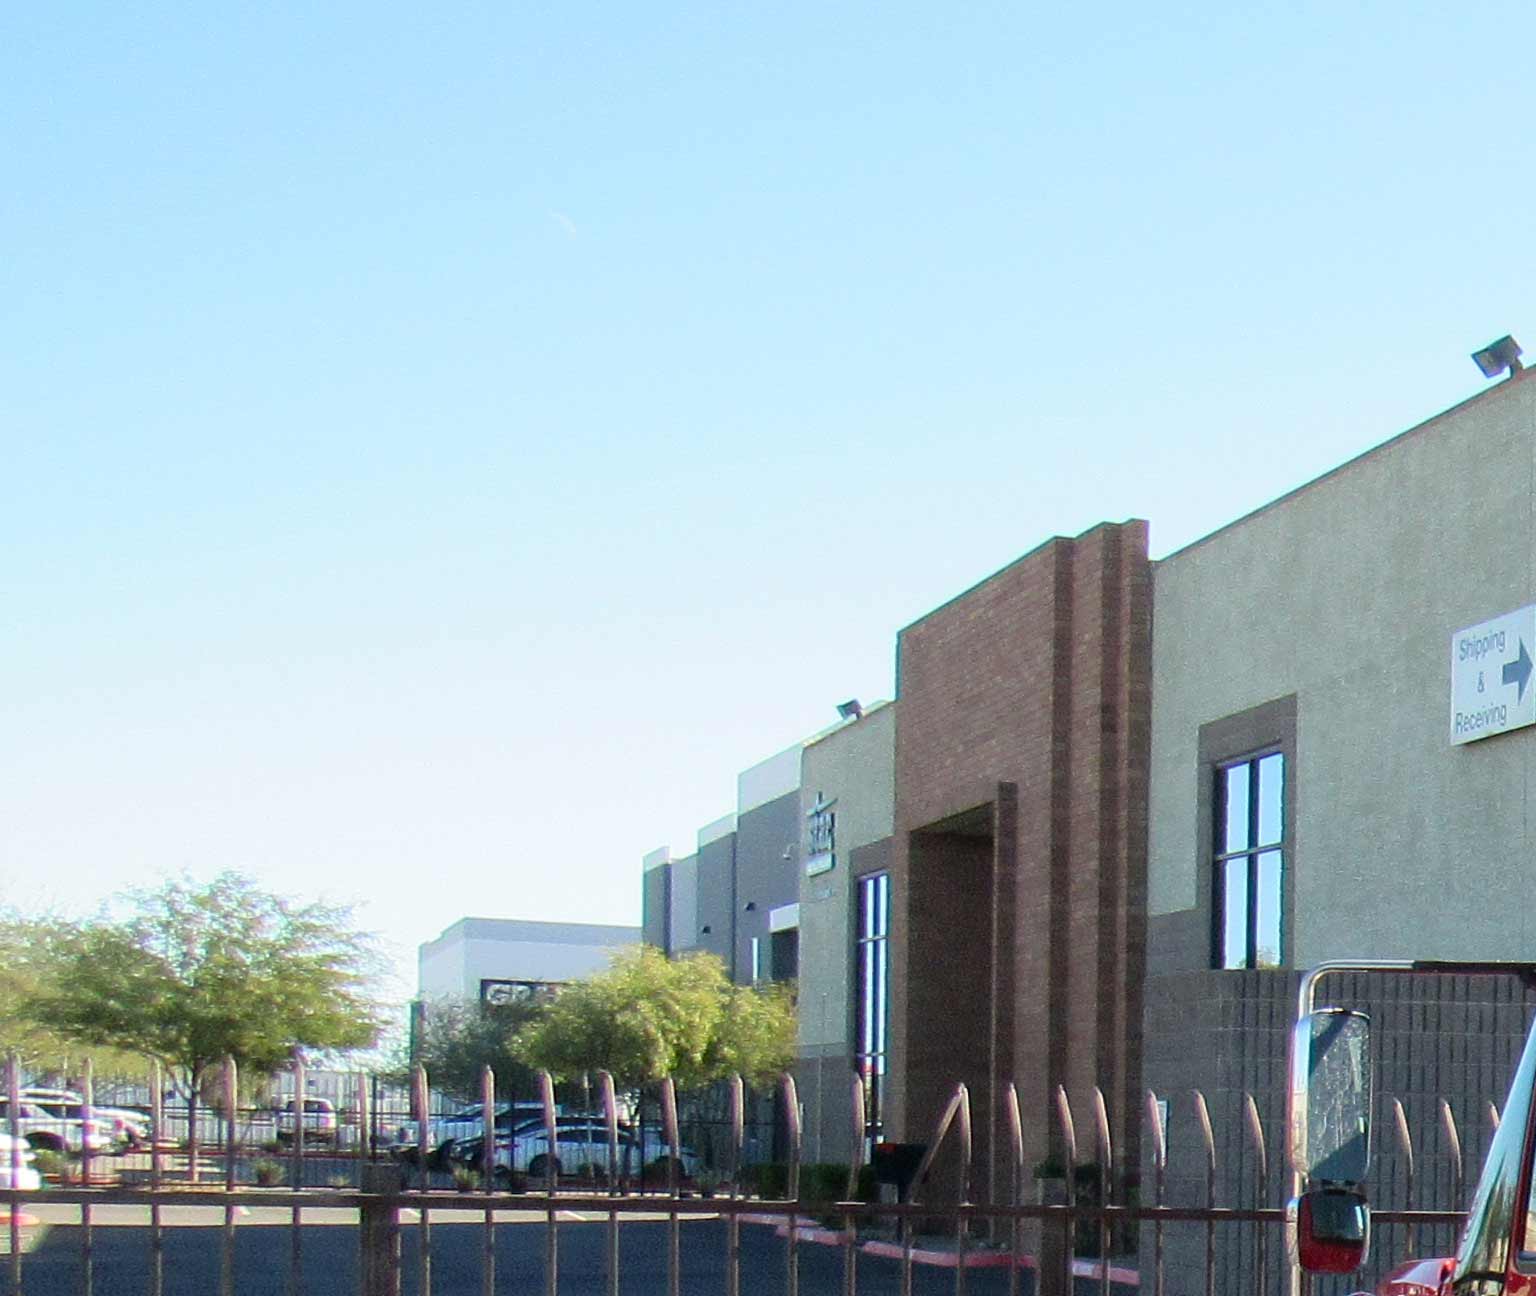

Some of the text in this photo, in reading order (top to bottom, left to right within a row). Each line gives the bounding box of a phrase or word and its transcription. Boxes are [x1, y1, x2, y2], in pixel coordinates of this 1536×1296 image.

[1459, 630, 1506, 662] Shipping
[1476, 671, 1485, 694] &
[1455, 703, 1507, 734] Receiving
